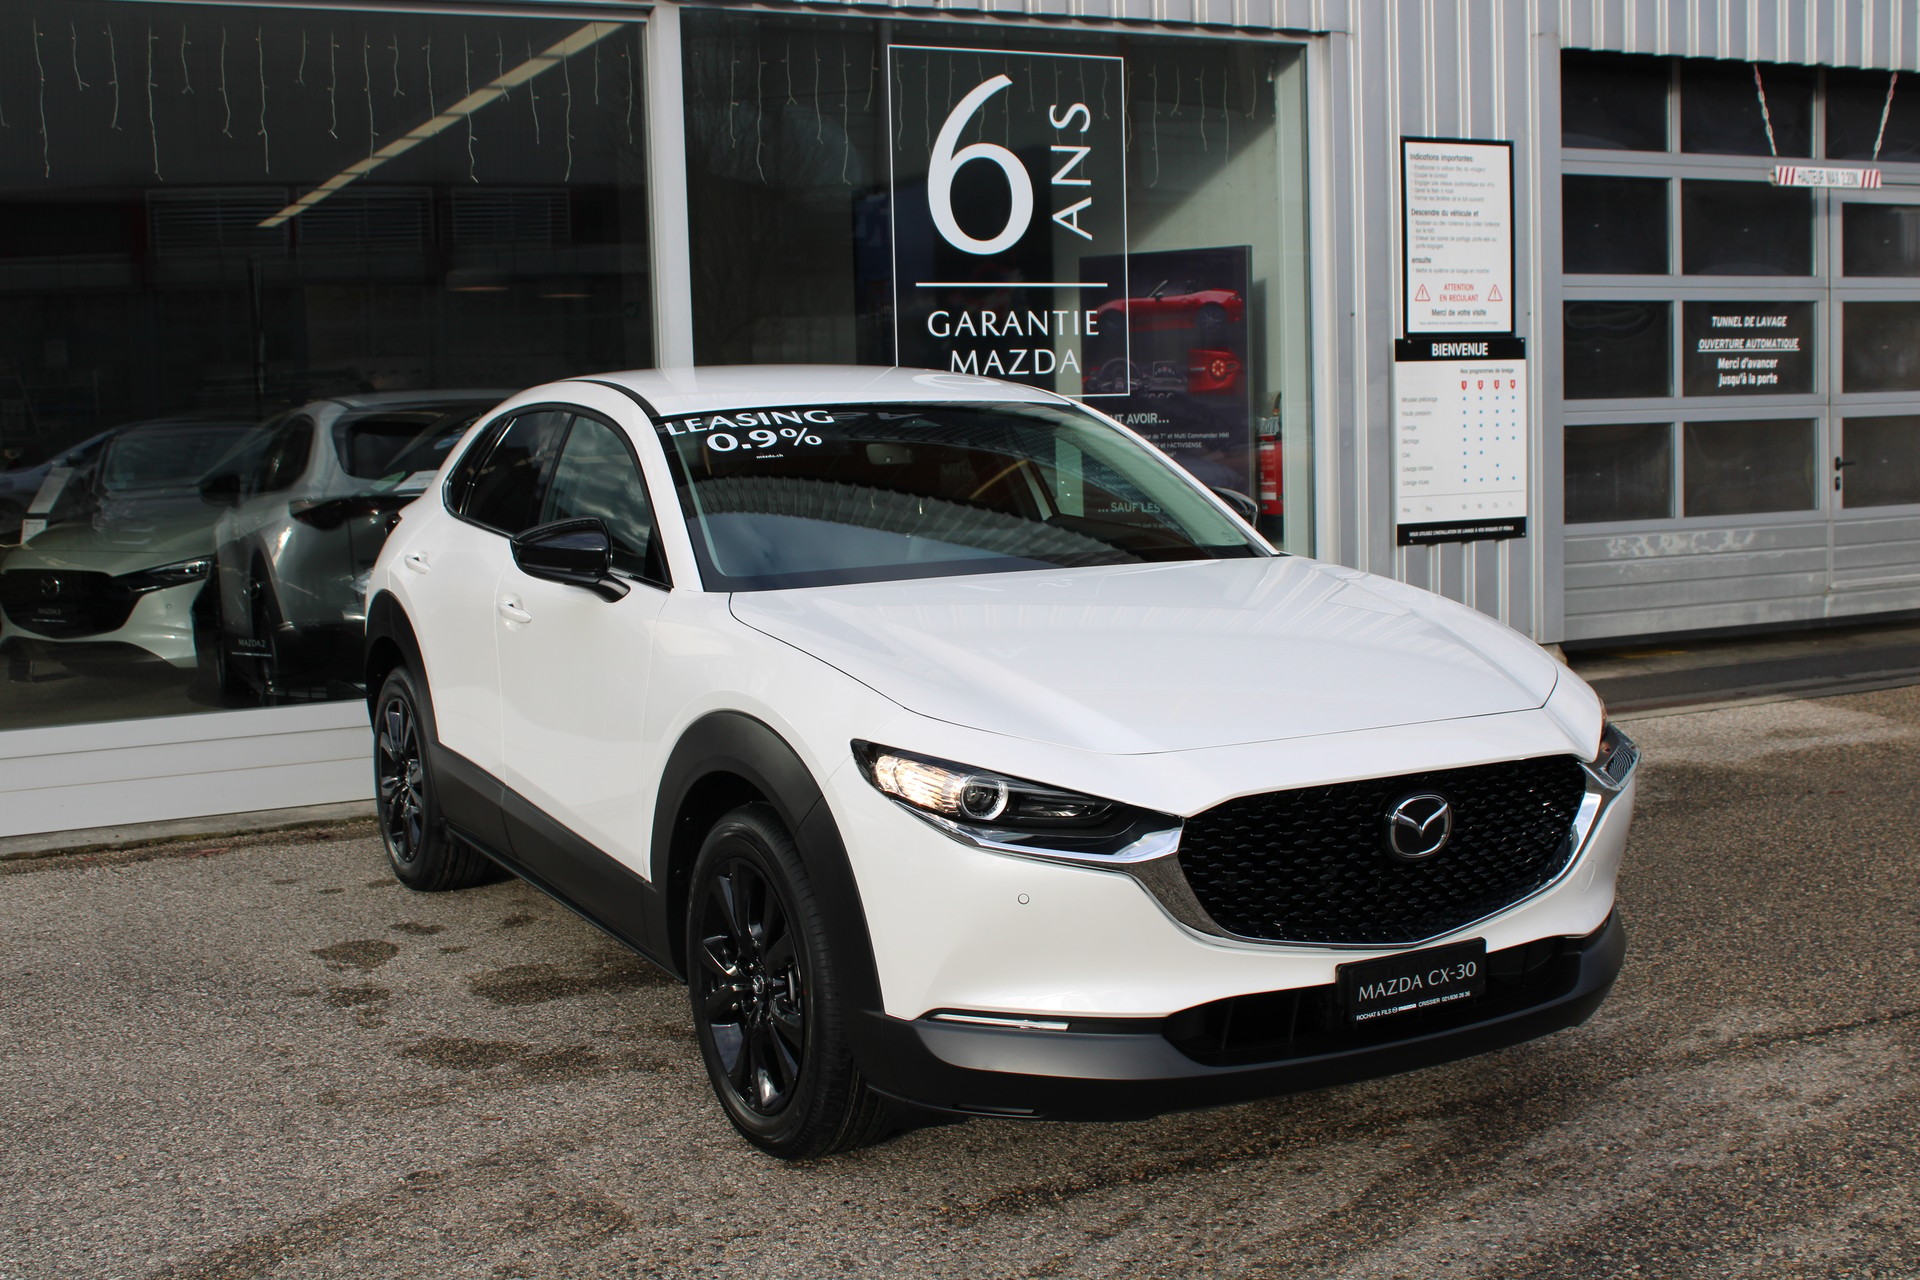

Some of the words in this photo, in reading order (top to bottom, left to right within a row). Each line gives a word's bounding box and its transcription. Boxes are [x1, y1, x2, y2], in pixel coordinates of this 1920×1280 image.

[927, 73, 1034, 255] 6
[1410, 153, 1439, 161] Indications
[1441, 153, 1473, 163] importantes
[1049, 102, 1093, 241] ANS
[1411, 208, 1440, 217] Descendre
[1441, 208, 1448, 216] du
[1450, 208, 1471, 217] véhicule
[1473, 208, 1479, 216] et
[1411, 256, 1432, 264] ensuite
[1443, 283, 1475, 291] ATTENTION
[1439, 294, 1447, 302] EN
[1449, 294, 1479, 302] RECULANT
[1431, 308, 1447, 317] Merci
[927, 310, 1100, 338] GARANTIE
[1711, 315, 1743, 328] TUNNEL
[1743, 315, 1755, 327] DE
[1756, 315, 1788, 328] LAVAGE
[1431, 342, 1489, 356] BIENVENUE
[1698, 338, 1744, 350] OUVERTURE
[1745, 337, 1800, 350] AUTOMATIQUE
[950, 348, 1081, 376] MAZDA
[1717, 357, 1740, 370] Merci
[1741, 357, 1778, 369] d'avancer
[1718, 372, 1747, 388] jusqu'à
[1748, 372, 1756, 385] la
[1757, 372, 1778, 388] porte
[664, 409, 835, 436] LEASING
[706, 427, 823, 452] 0.9%
[1358, 974, 1423, 1002] MAZDA
[1427, 961, 1477, 986] CX-30
[1356, 1011, 1377, 1021] ROCHAT
[1381, 1008, 1392, 1016] FILS
